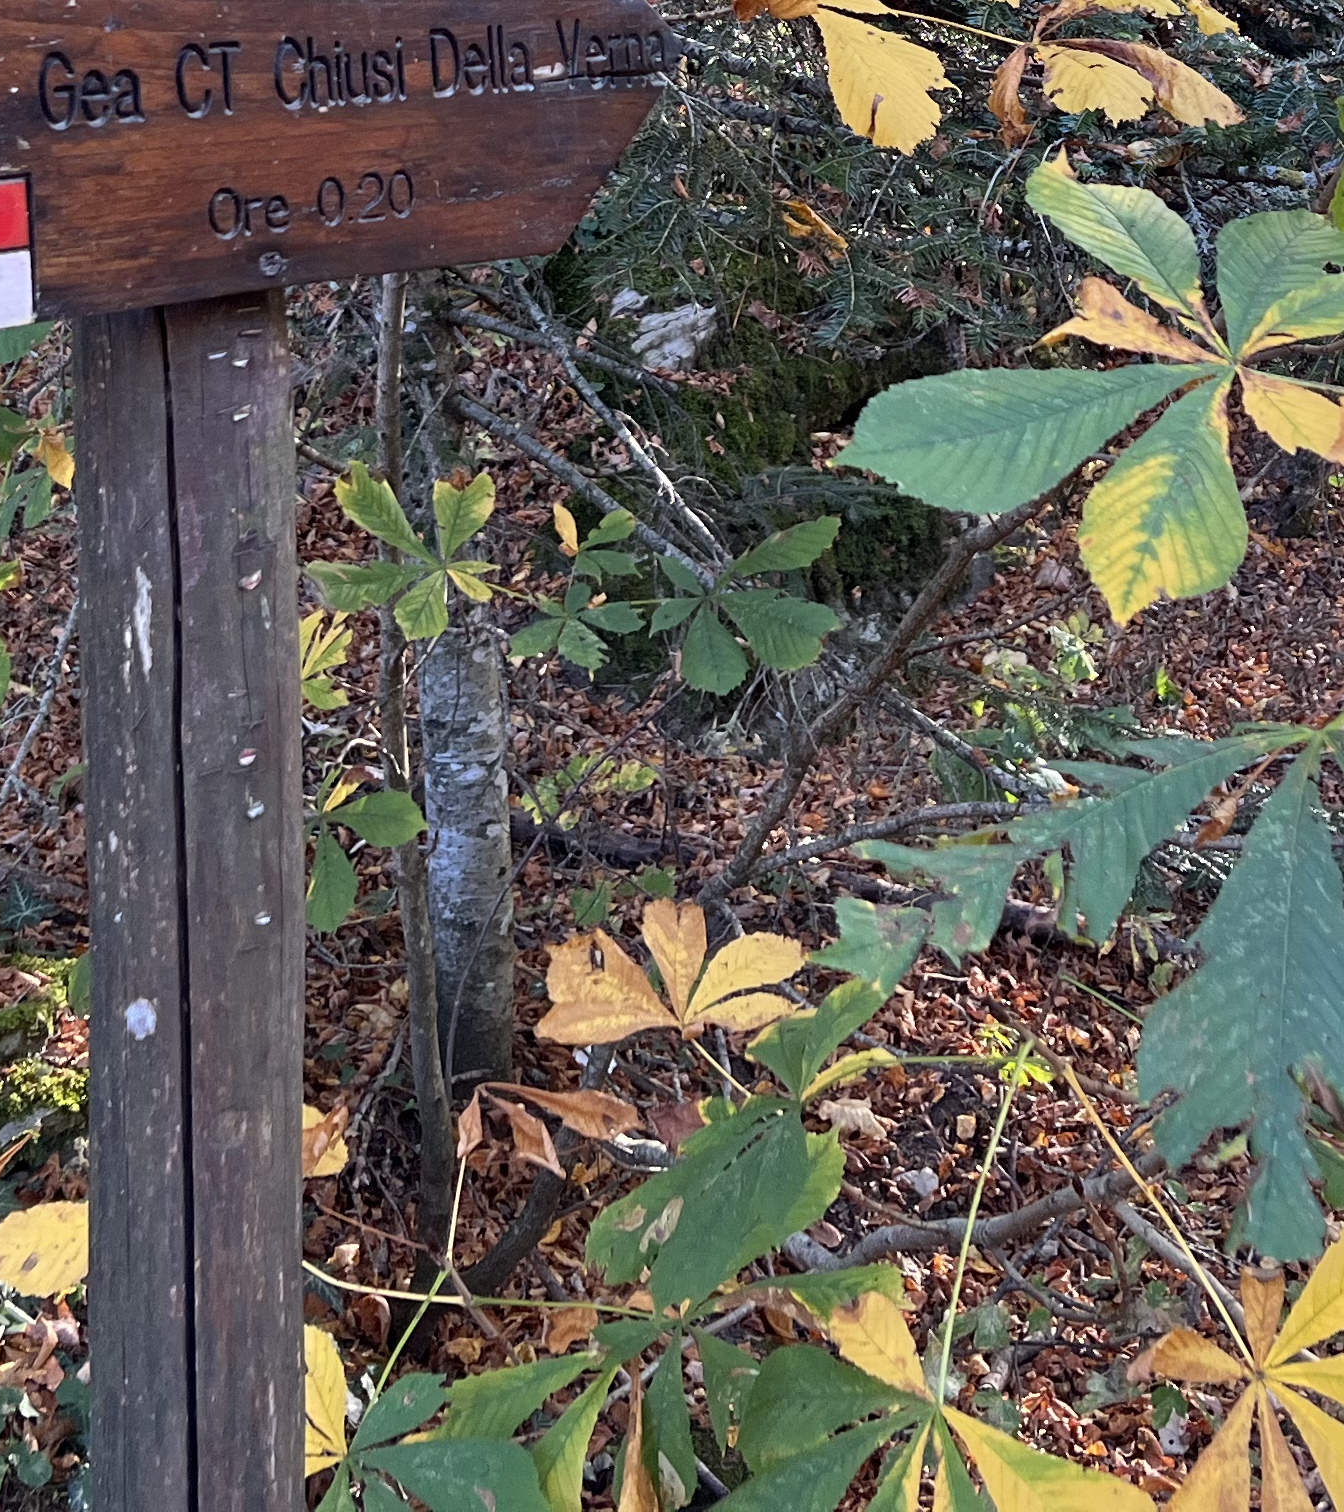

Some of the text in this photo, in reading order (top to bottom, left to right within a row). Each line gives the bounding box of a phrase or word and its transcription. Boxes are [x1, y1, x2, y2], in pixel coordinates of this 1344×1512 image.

[38, 50, 146, 131] Gea
[175, 39, 241, 119] CT
[273, 35, 407, 111] Chiusi
[428, 24, 535, 98] Della
[208, 169, 416, 240] Ore 0.20
